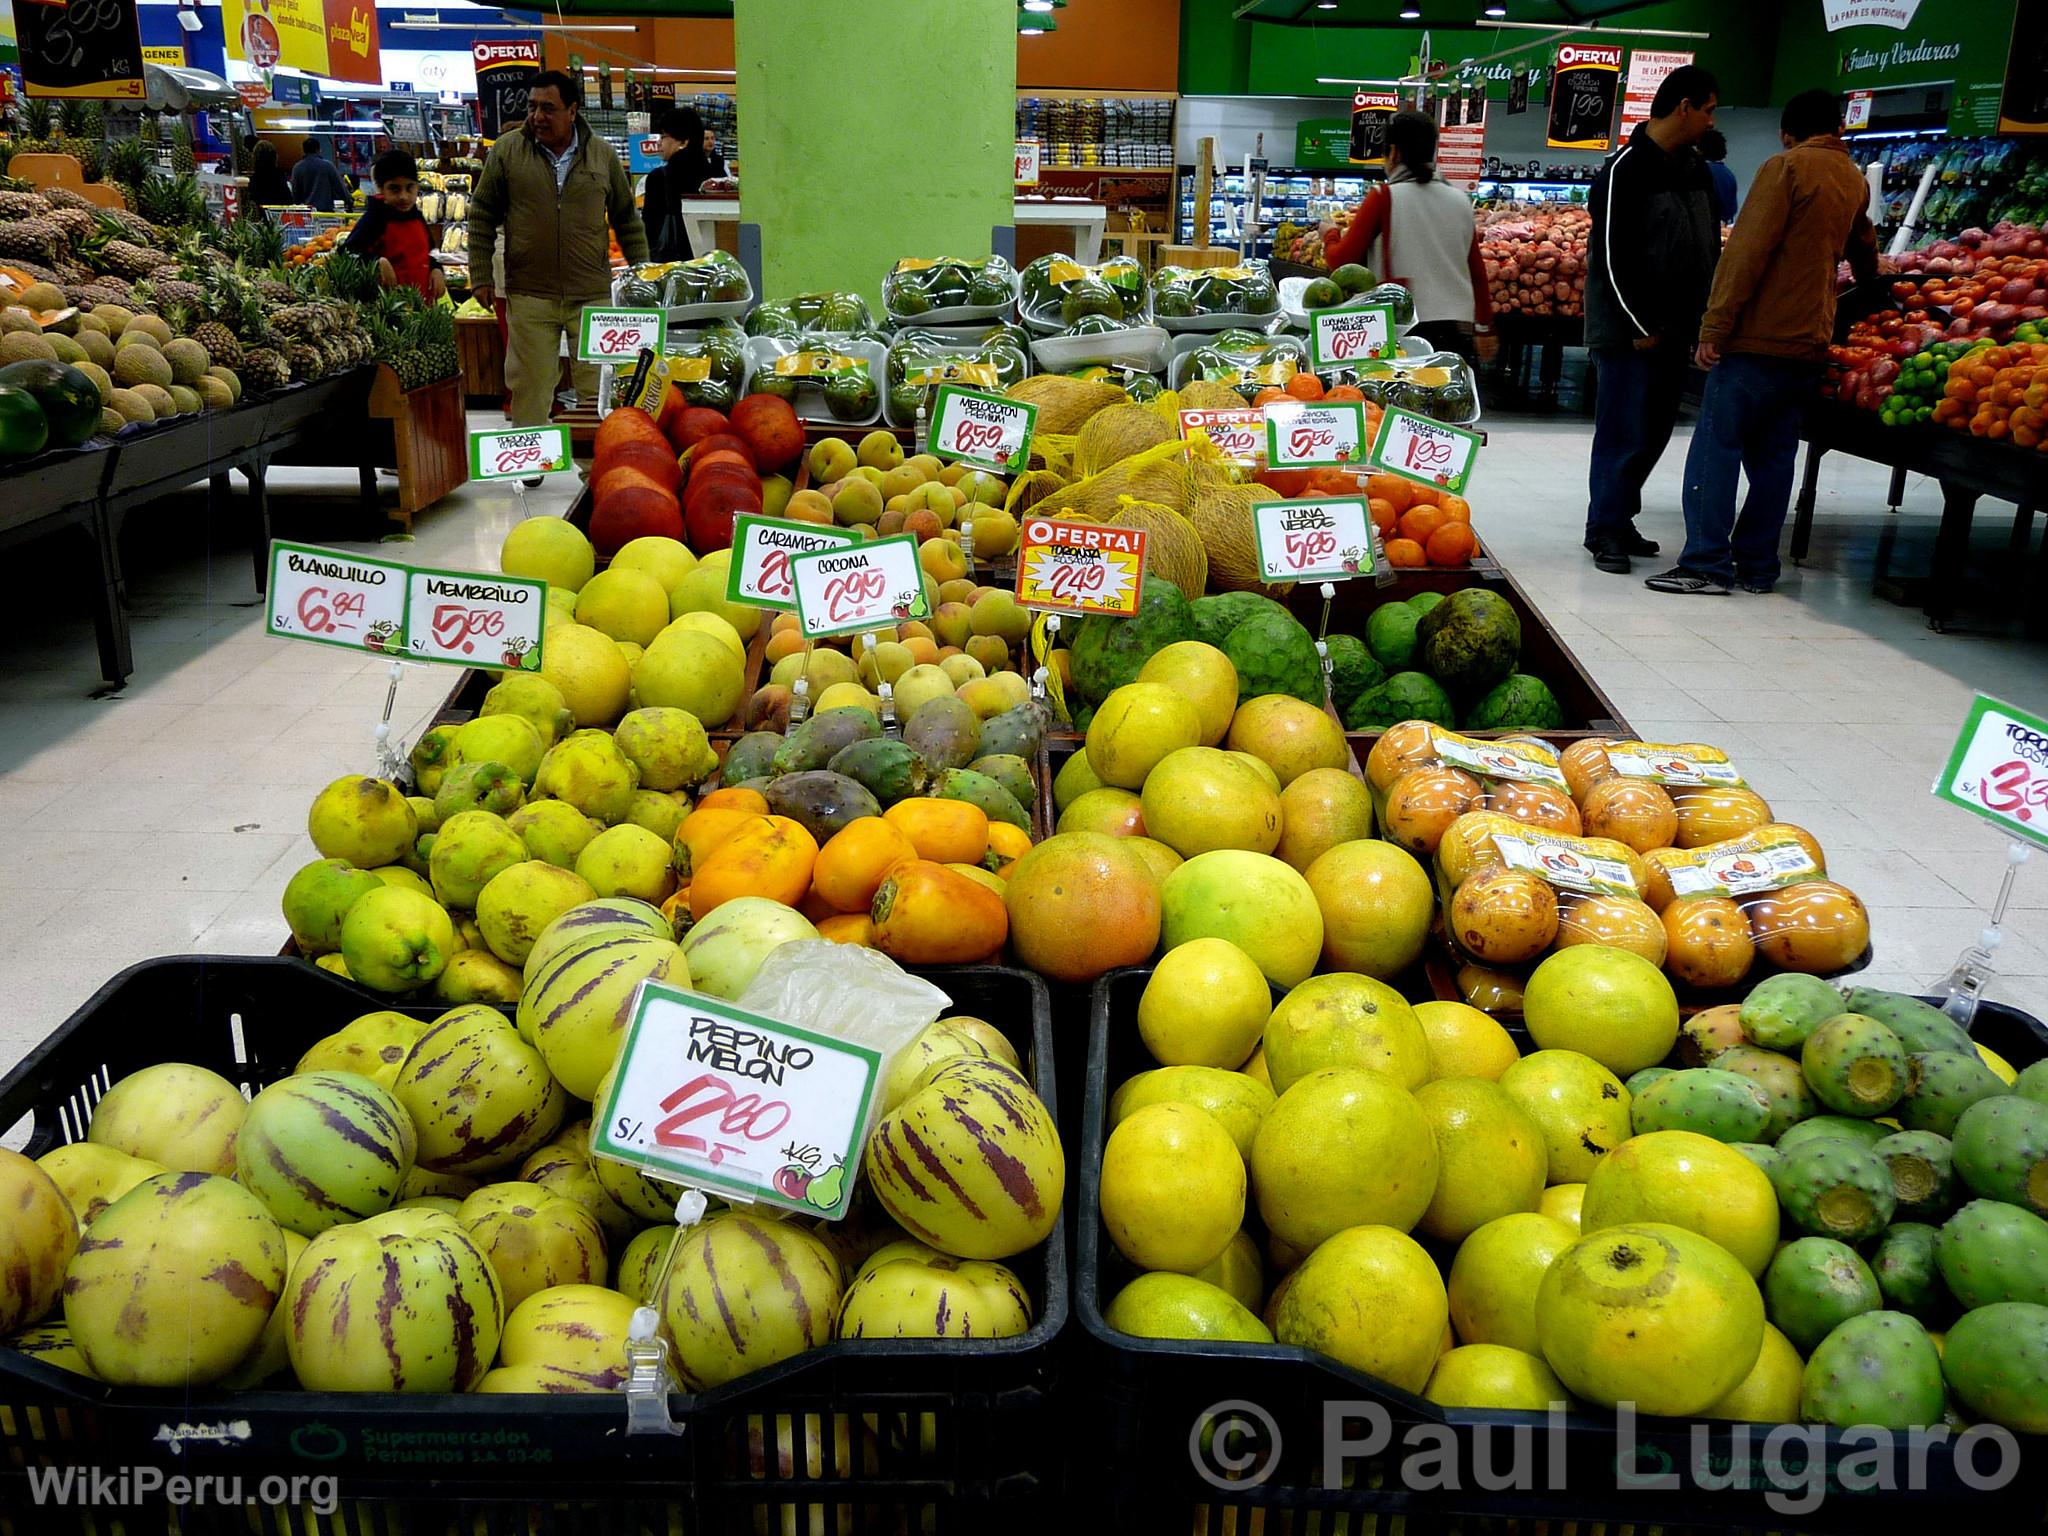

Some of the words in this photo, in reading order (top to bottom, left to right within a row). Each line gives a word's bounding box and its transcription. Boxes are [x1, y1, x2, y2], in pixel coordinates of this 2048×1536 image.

[1841, 9, 1859, 21] PAPA
[1861, 8, 1869, 16] ES
[142, 50, 179, 58] GENES
[474, 44, 538, 61] OFERTA!
[1559, 47, 1621, 65] OFERTA!
[1848, 48, 1879, 72] Frutas
[1879, 51, 1889, 72] y
[1891, 39, 1961, 65] Verduras
[423, 66, 447, 79] city
[1455, 58, 1511, 80] Fruta
[1528, 69, 1541, 86] y
[1355, 94, 1399, 106] OFERTA!
[599, 329, 641, 354] 3.45
[1332, 330, 1368, 359] 6.57
[960, 398, 1018, 418] MELOCOTON
[965, 408, 1005, 424] PREMIUM
[956, 420, 1004, 454] 8.59
[1288, 428, 1335, 458] 5.56
[495, 447, 542, 473] 2.55
[1405, 434, 1452, 471] 1.99
[1280, 517, 1336, 531] VERDE
[1281, 508, 1325, 519] TUNA
[1028, 521, 1140, 552] OFERTA!
[818, 555, 869, 574] COCONA
[1049, 545, 1102, 560] TORONJA
[1267, 563, 1282, 574] S/.
[1285, 531, 1336, 569] 5.85
[288, 554, 386, 585] BLANQUILLO
[1050, 565, 1105, 602] 2.49
[275, 615, 292, 629] S/.
[297, 587, 366, 633] 6.84
[808, 617, 825, 630] S/.
[823, 568, 886, 623] 2.95
[412, 639, 428, 651] S/.
[432, 604, 505, 654] 5.53
[2013, 742, 2048, 768] COST
[1961, 782, 1976, 796] S/.
[687, 1039, 785, 1087] MELON
[615, 1117, 645, 1144] S/.
[361, 1427, 531, 1447] Supermercados
[364, 1447, 464, 1463] Peruanos
